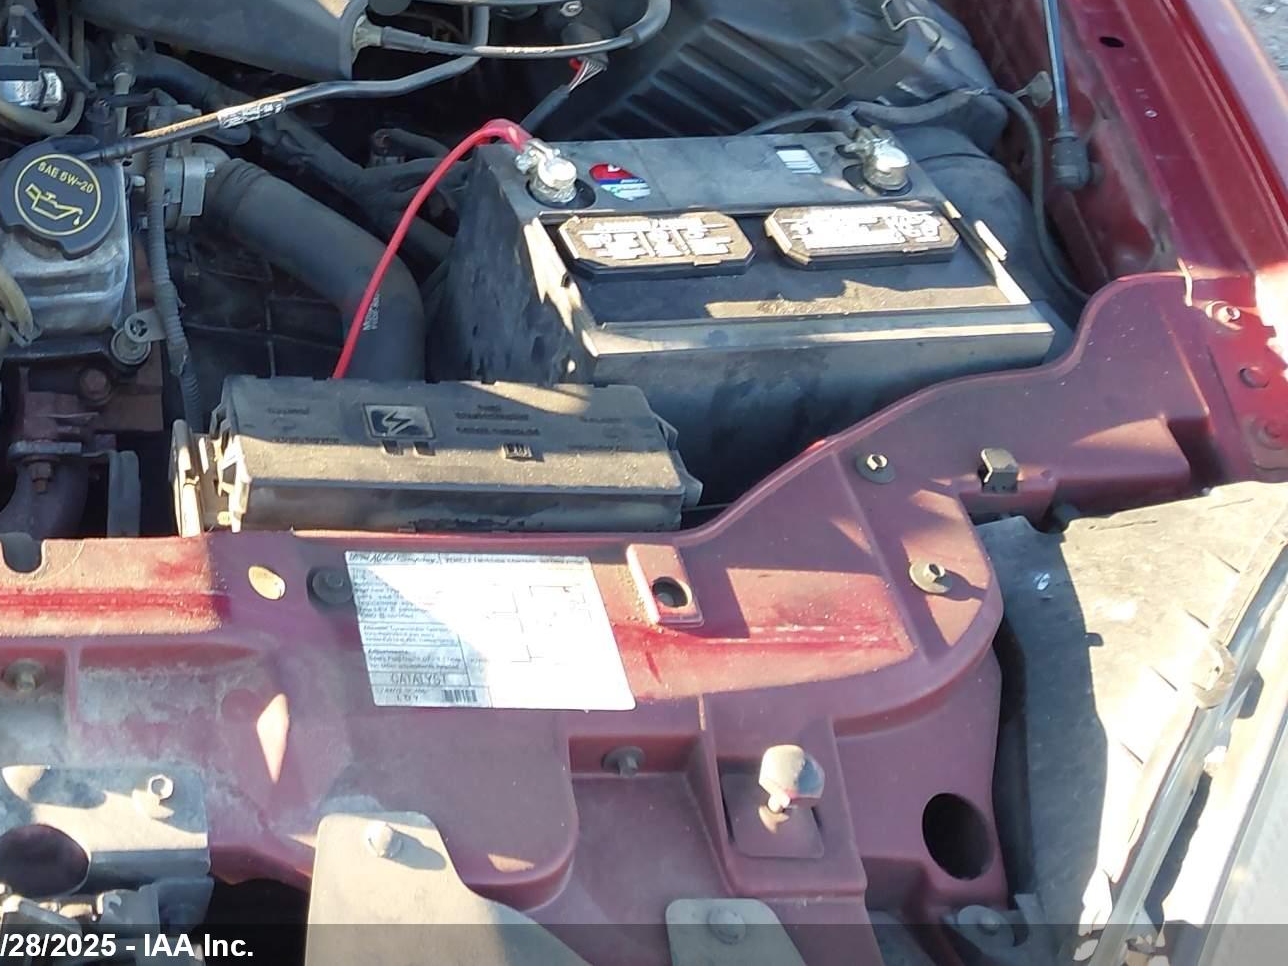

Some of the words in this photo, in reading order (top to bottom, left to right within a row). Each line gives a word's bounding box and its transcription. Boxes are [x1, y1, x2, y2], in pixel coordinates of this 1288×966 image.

[38, 161, 58, 179] SAE
[59, 171, 95, 194] 5W-20
[391, 674, 446, 687] CATALYST
